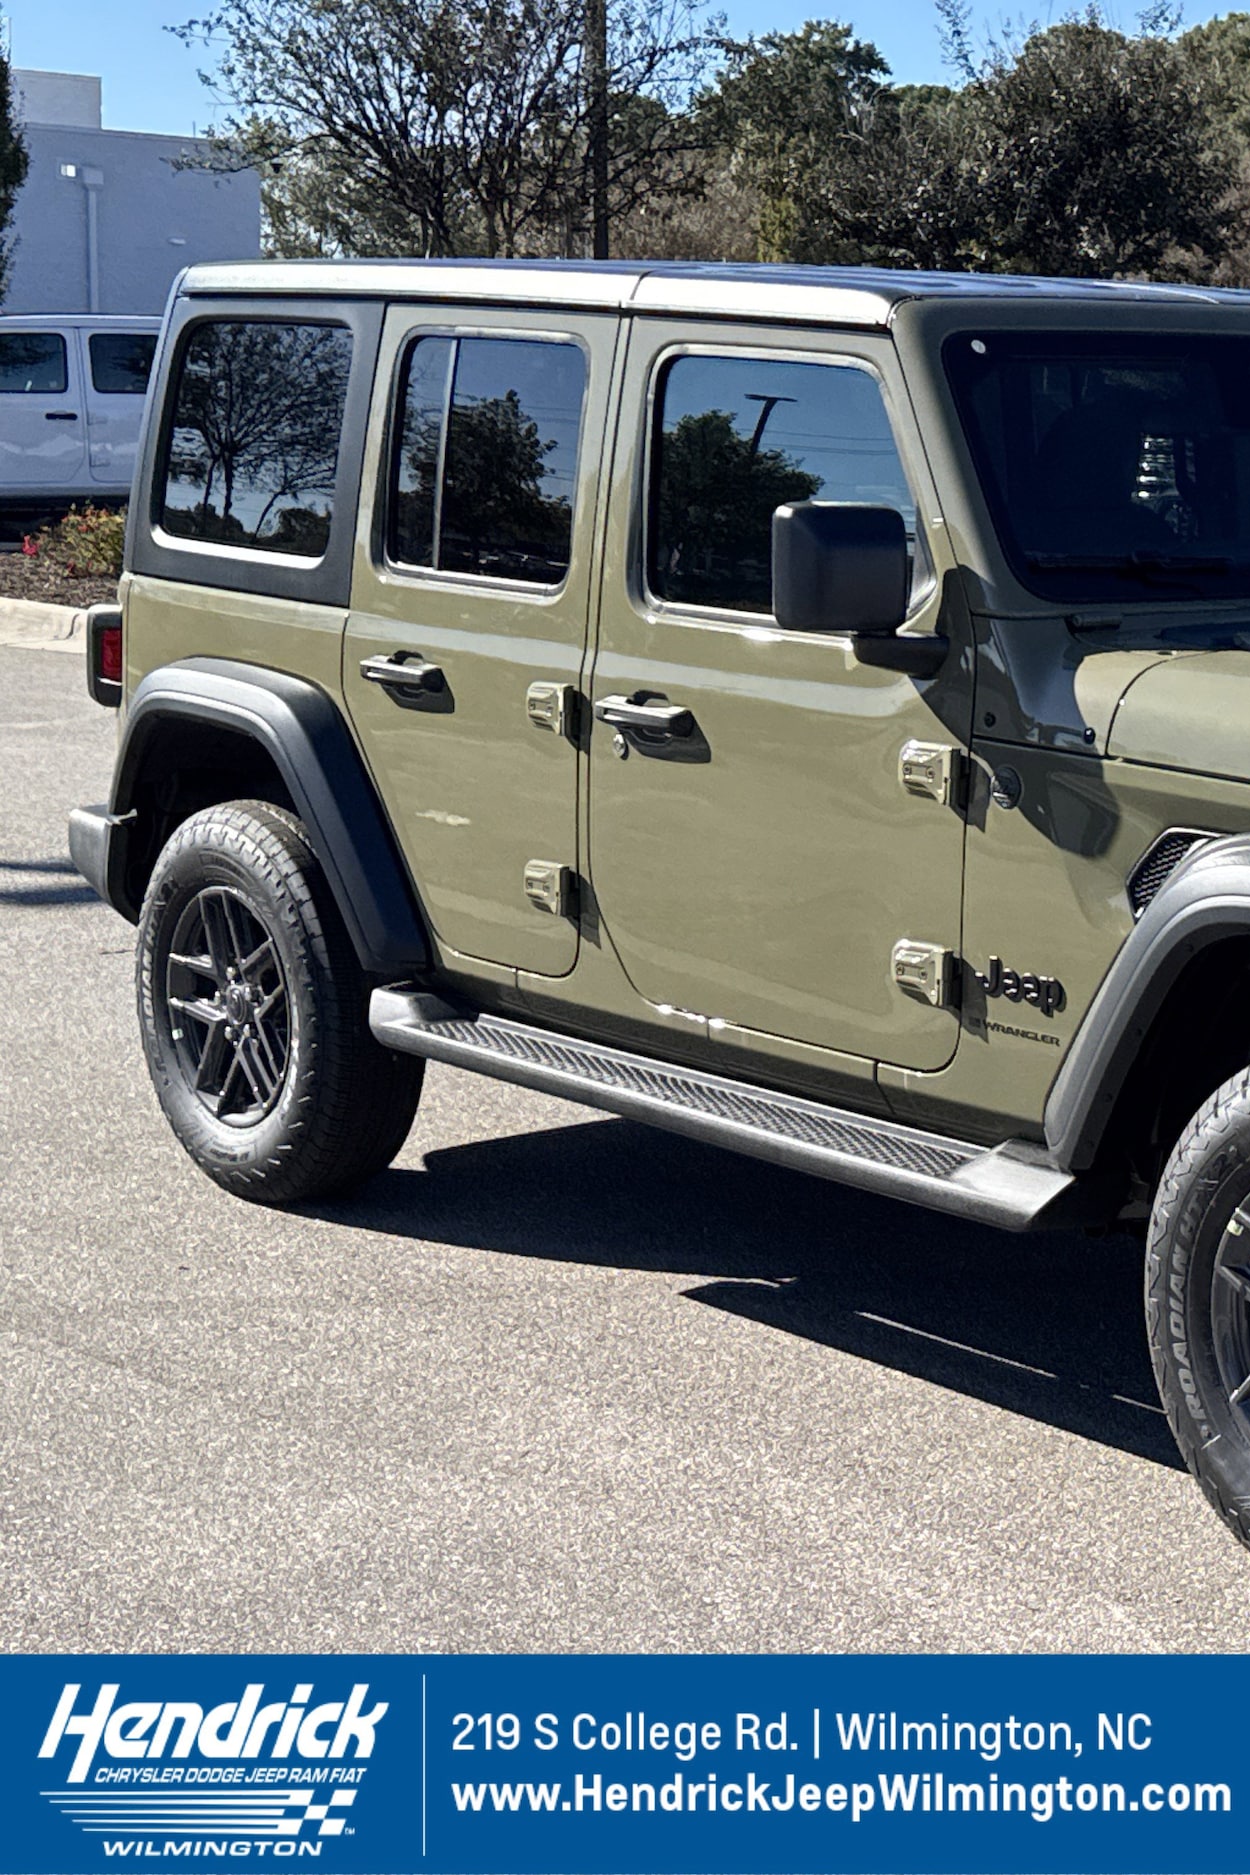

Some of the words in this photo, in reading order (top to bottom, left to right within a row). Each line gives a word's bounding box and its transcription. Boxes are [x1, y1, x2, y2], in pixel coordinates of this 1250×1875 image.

[975, 955, 1066, 1018] Jeep
[983, 1020, 1061, 1047] WRANGLER
[1169, 1243, 1206, 1421] ROADIAN
